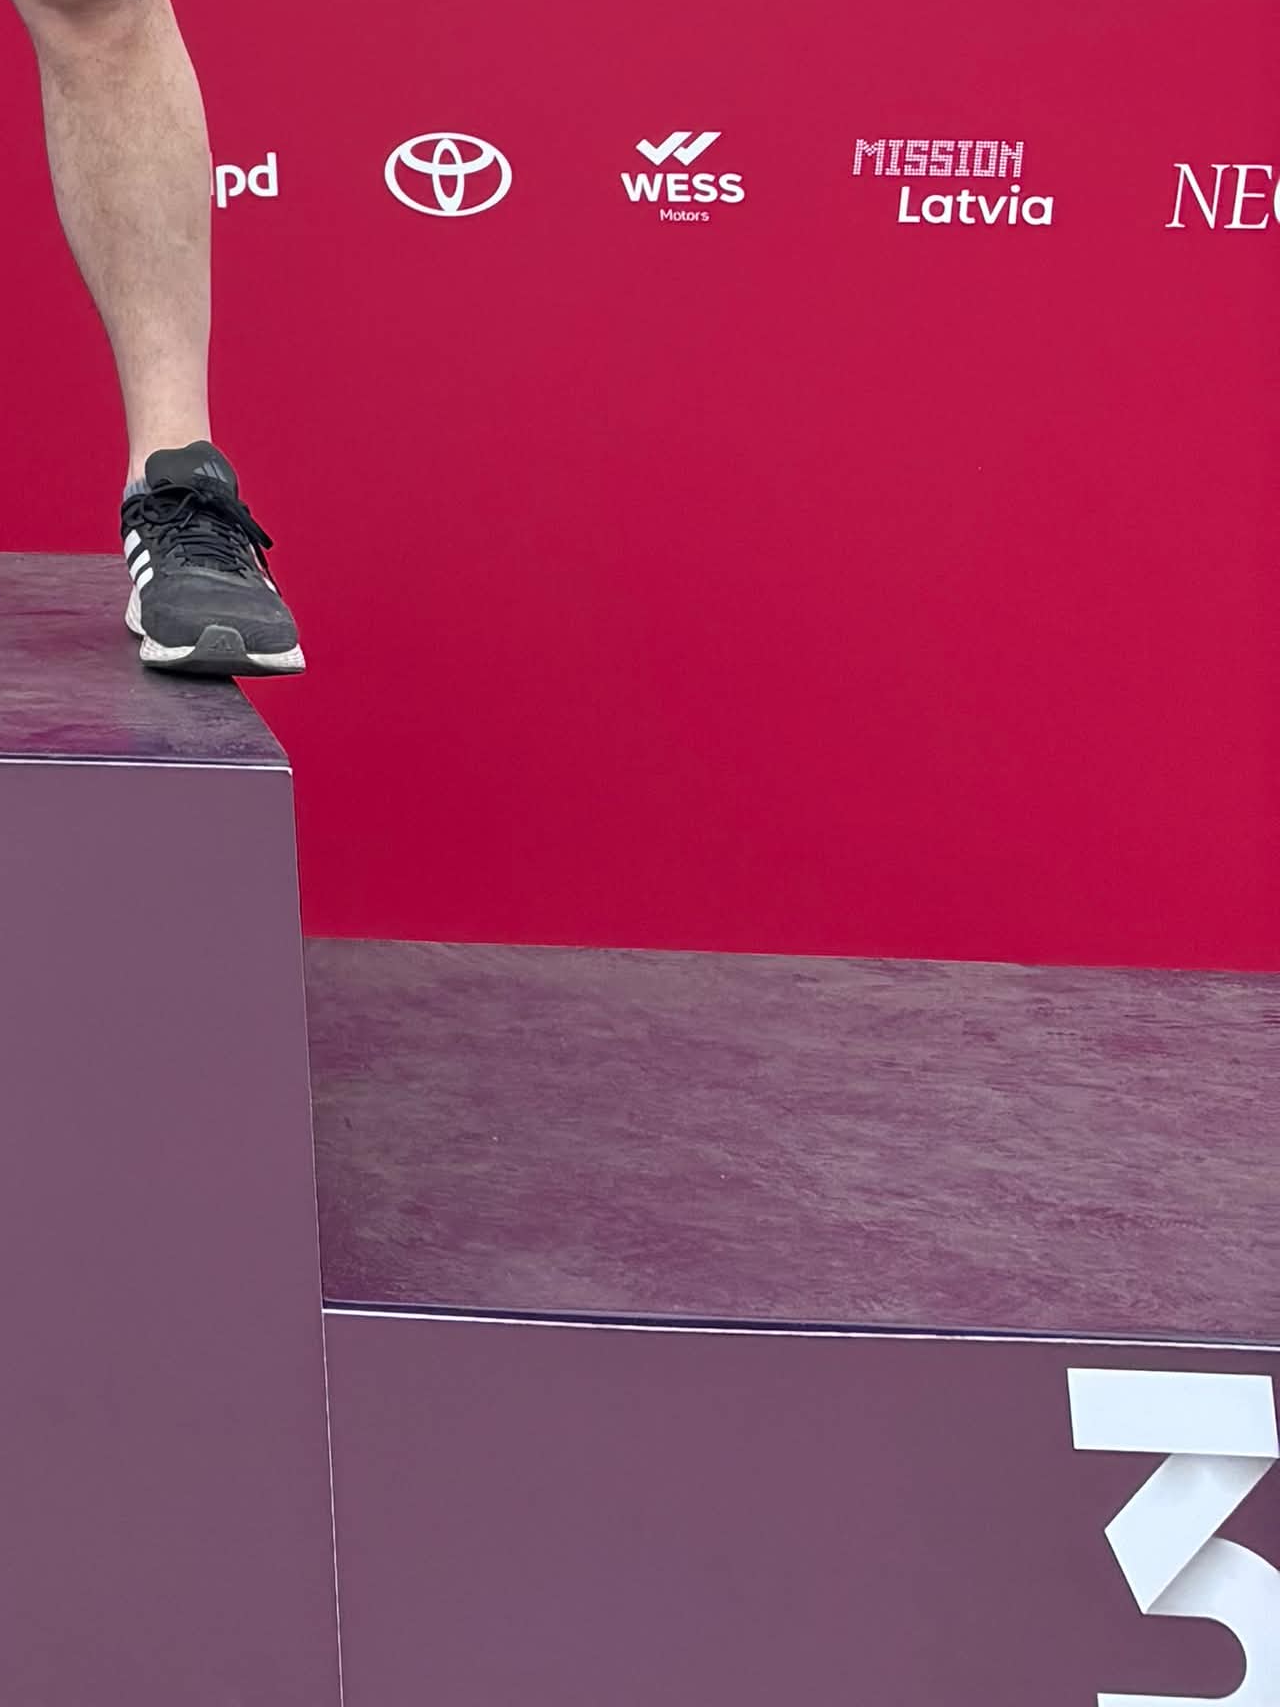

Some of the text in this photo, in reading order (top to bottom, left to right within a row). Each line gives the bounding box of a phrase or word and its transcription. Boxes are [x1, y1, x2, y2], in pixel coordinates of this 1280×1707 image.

[853, 139, 1023, 177] MISSION
[216, 153, 278, 207] pd
[621, 173, 744, 202] WESS
[659, 209, 710, 223] Motors
[899, 185, 1053, 225] Latvia
